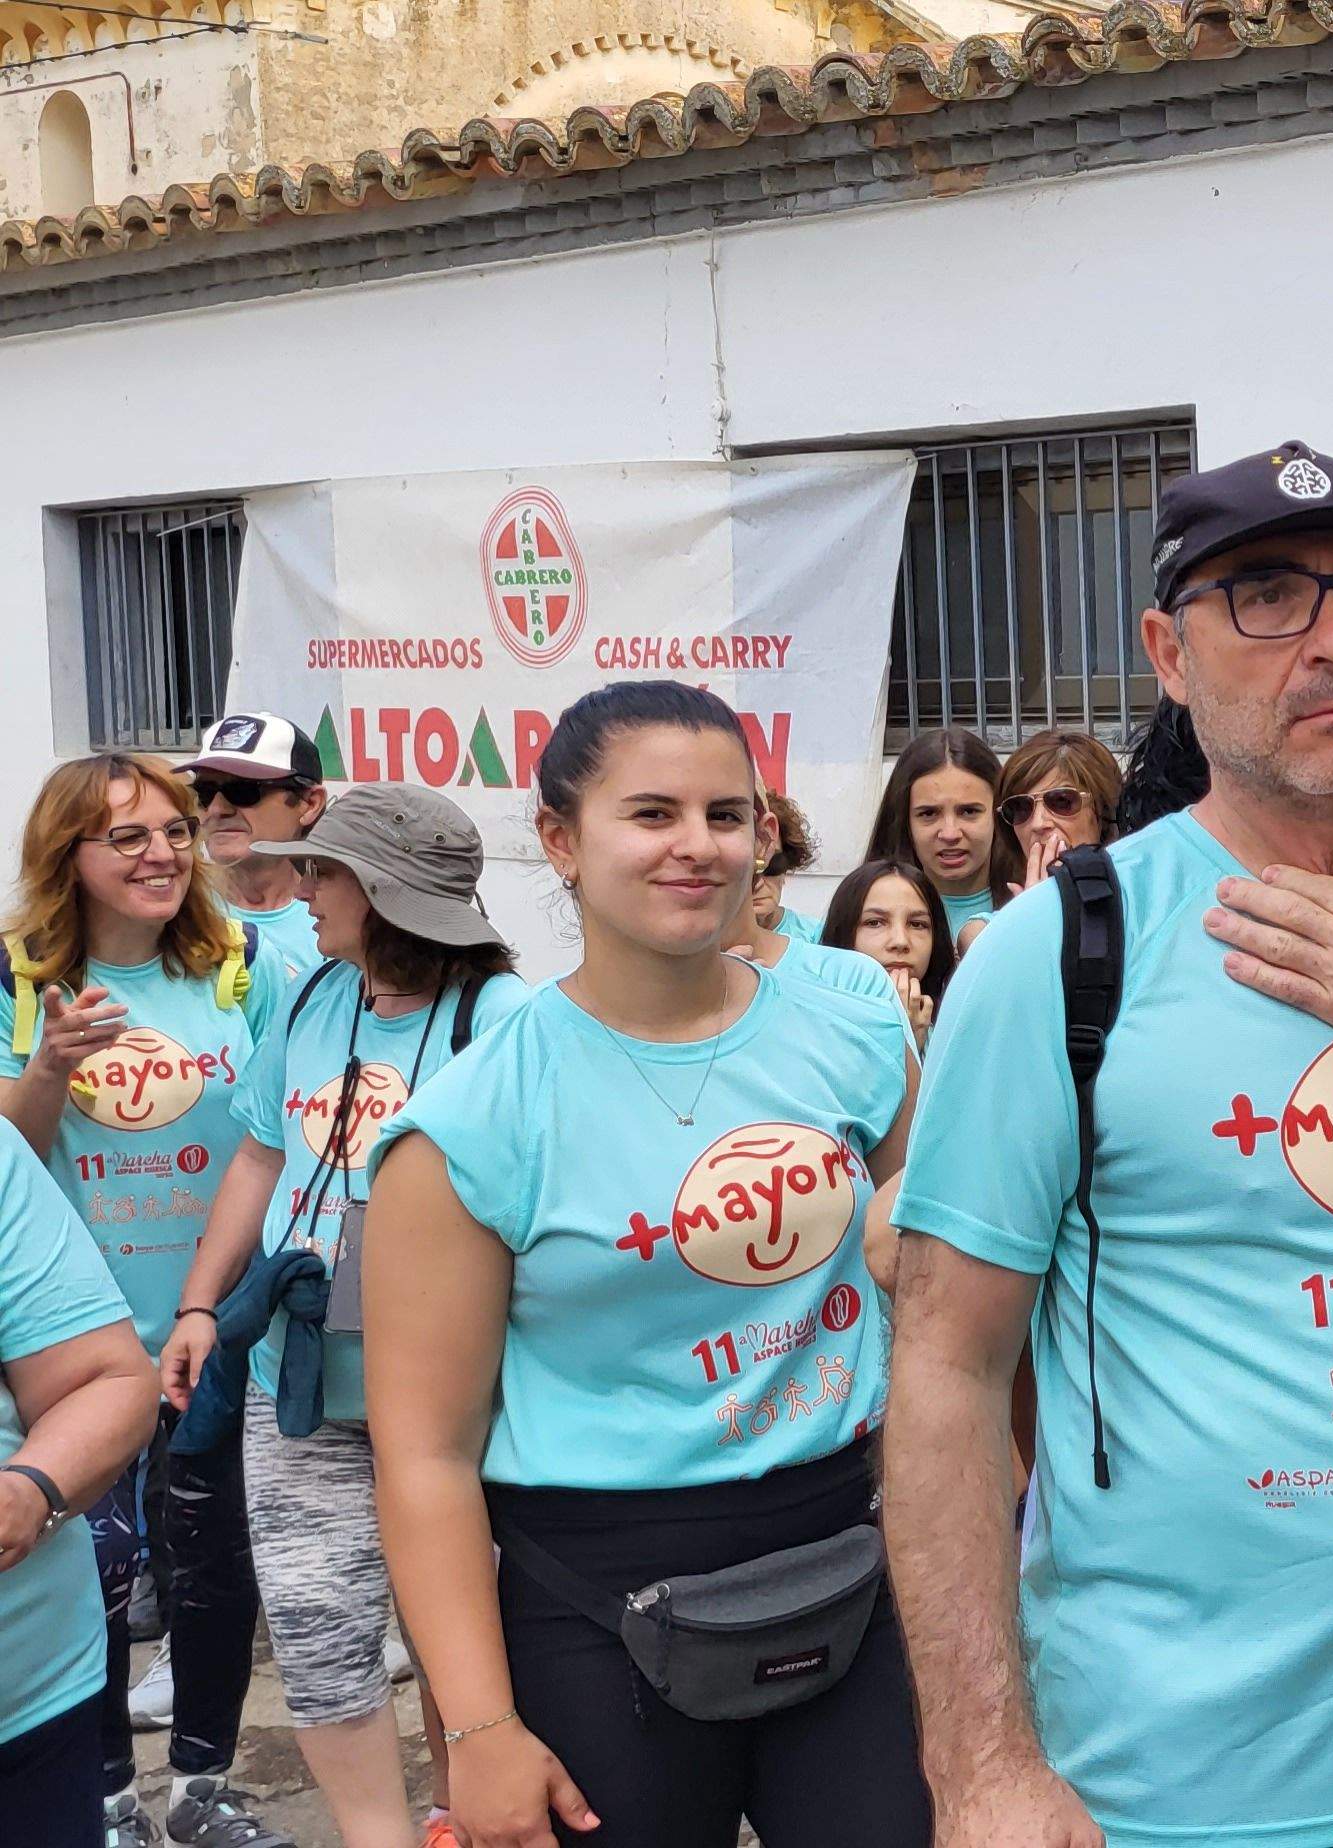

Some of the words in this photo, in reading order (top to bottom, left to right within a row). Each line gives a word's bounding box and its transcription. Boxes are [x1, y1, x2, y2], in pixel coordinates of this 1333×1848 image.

[494, 568, 573, 587] CABRERO
[307, 637, 483, 669] SUPERMERCADOS
[594, 636, 663, 670] CASH
[666, 636, 688, 670] &
[690, 634, 793, 669] CARRY
[314, 700, 792, 796] ALTOARN
[753, 1341, 793, 1363] ASPACE
